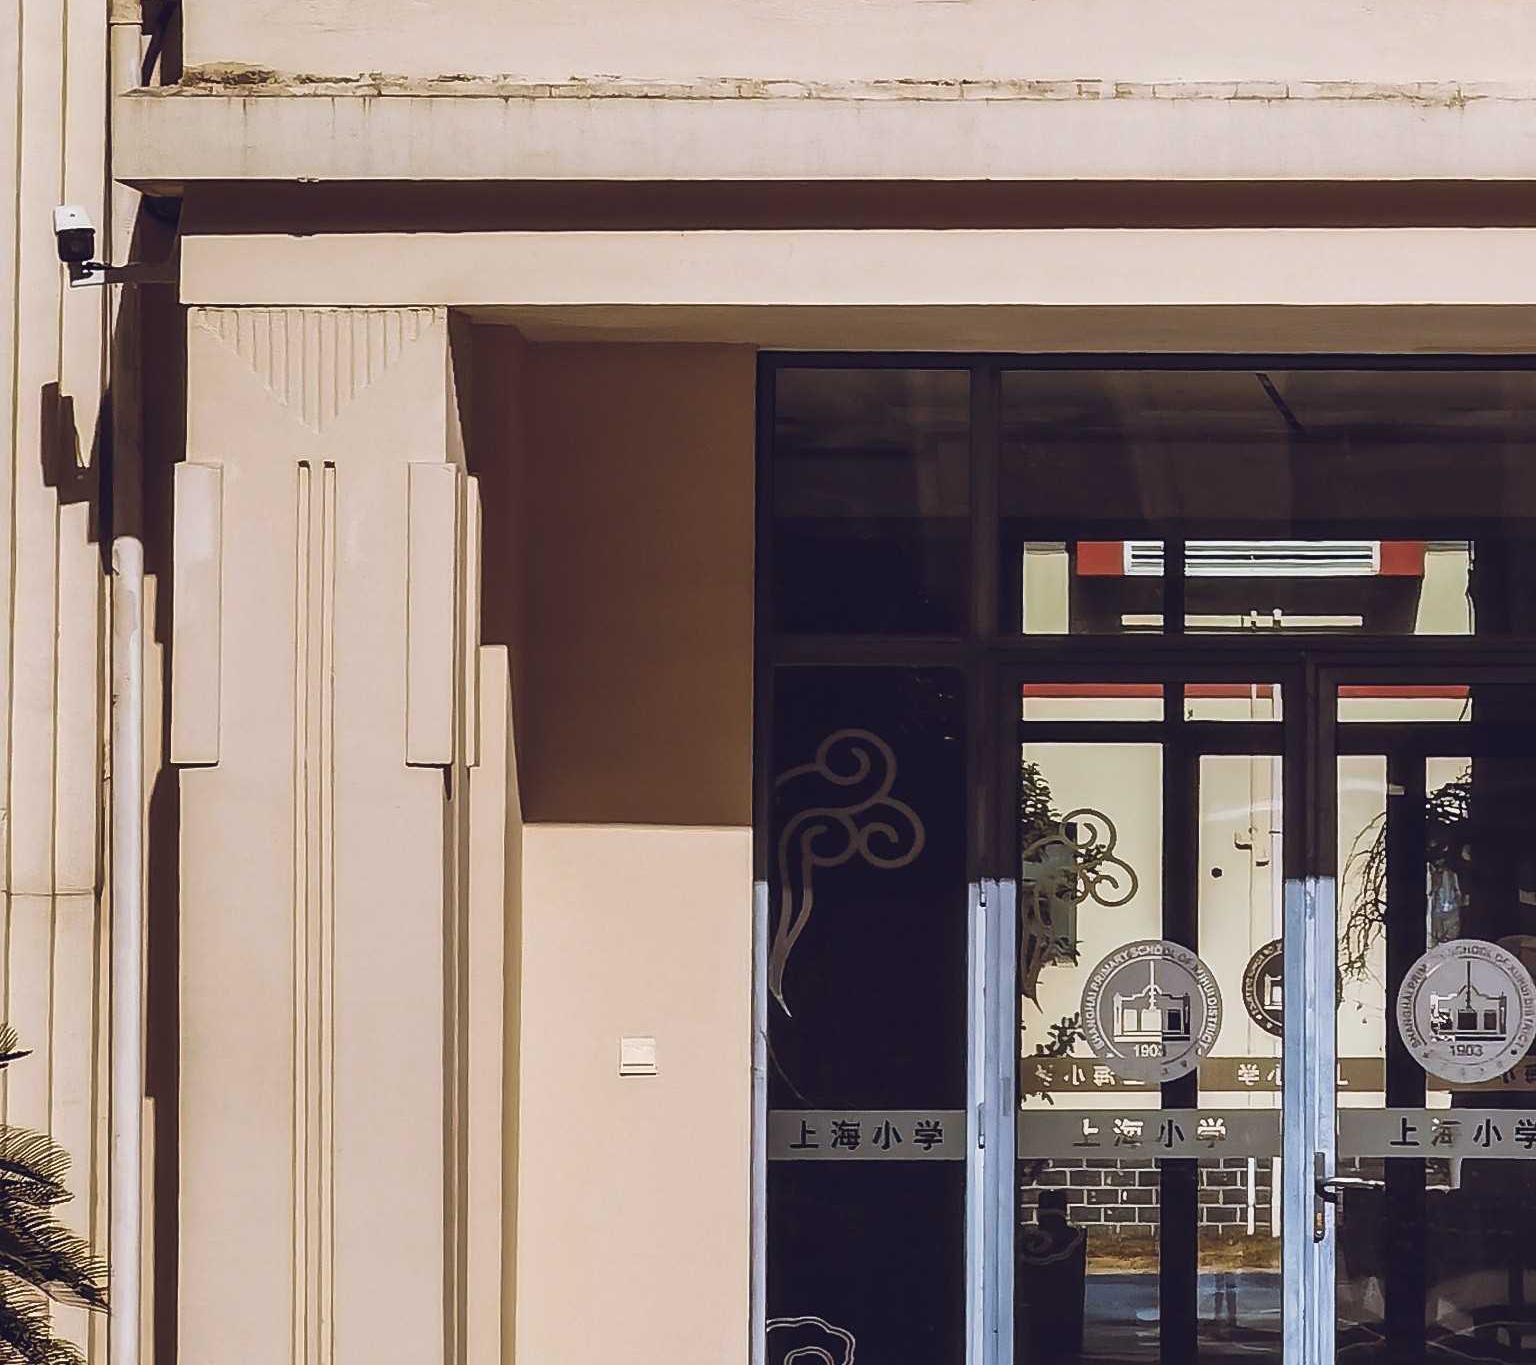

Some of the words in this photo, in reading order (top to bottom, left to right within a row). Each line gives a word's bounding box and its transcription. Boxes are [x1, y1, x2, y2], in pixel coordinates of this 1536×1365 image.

[1449, 1044, 1484, 1057] 1903
[790, 1119, 944, 1151] 上海小学
[1072, 1117, 1228, 1150] 上海小学
